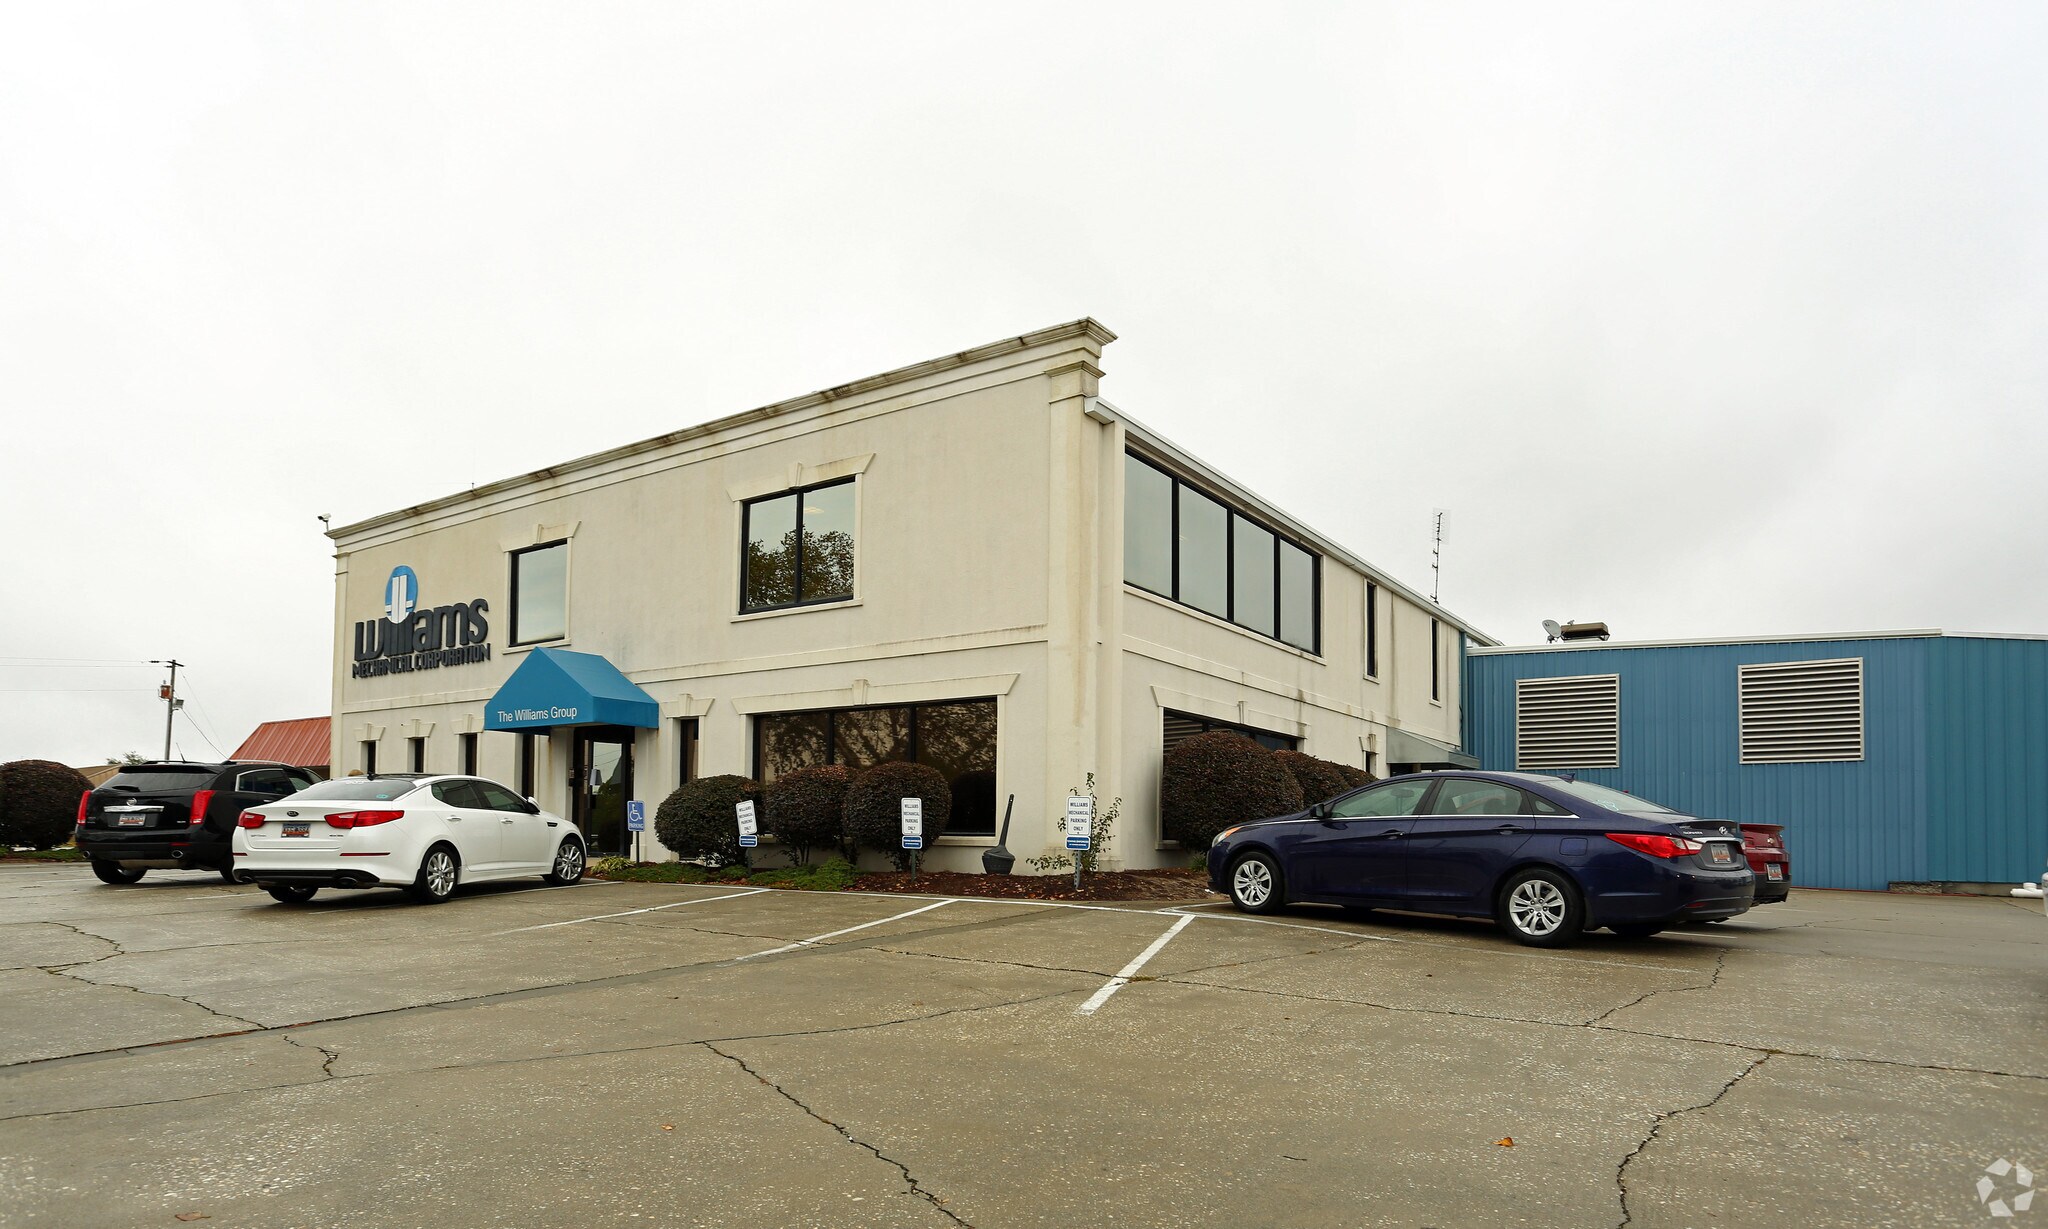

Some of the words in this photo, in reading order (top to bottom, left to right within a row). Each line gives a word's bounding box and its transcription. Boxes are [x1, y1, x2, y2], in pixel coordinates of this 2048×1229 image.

[354, 575, 489, 661] Williams
[352, 654, 414, 679] MECHANICAL
[414, 643, 491, 671] CORPORATION
[498, 710, 513, 722] The
[514, 708, 549, 721] Williams
[550, 706, 578, 720] Group
